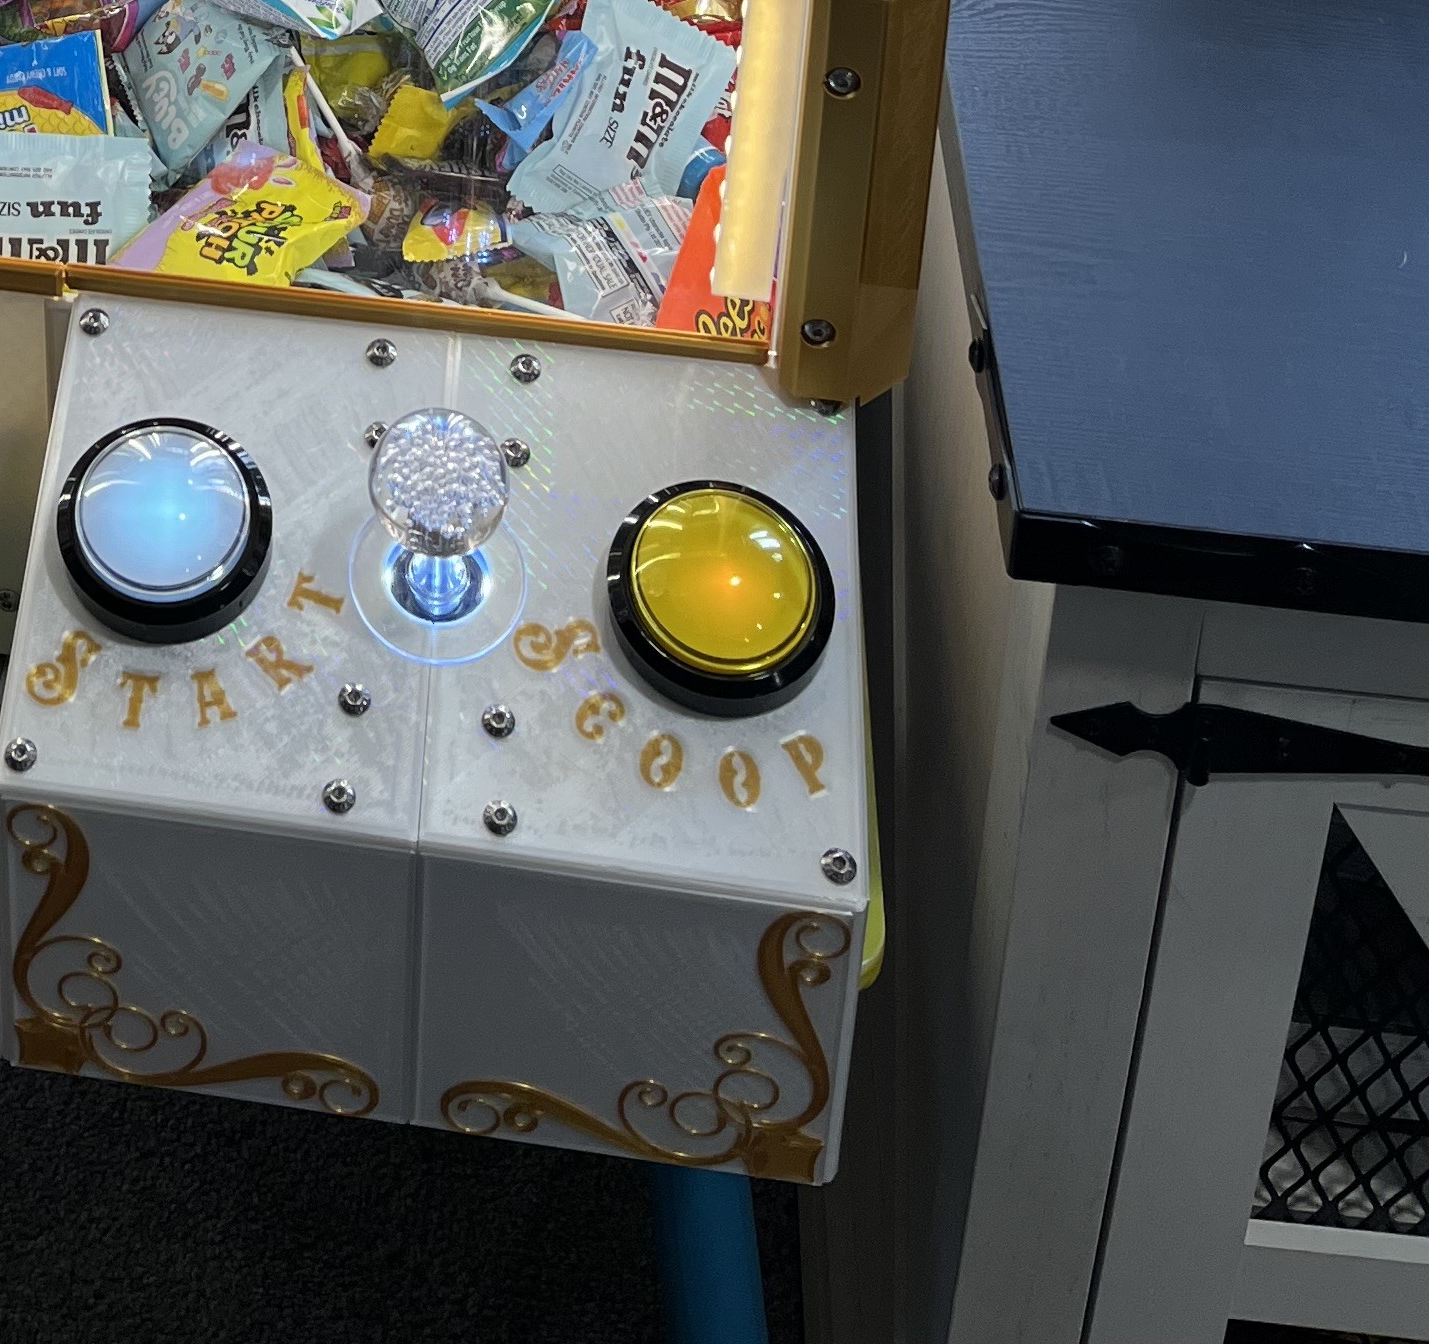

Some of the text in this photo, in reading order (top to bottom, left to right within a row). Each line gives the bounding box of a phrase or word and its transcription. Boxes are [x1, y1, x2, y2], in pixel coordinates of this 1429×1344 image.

[599, 46, 646, 150] fun SIZE
[25, 199, 103, 226] fun
[24, 570, 346, 730] START
[513, 616, 828, 812] SCOOP
